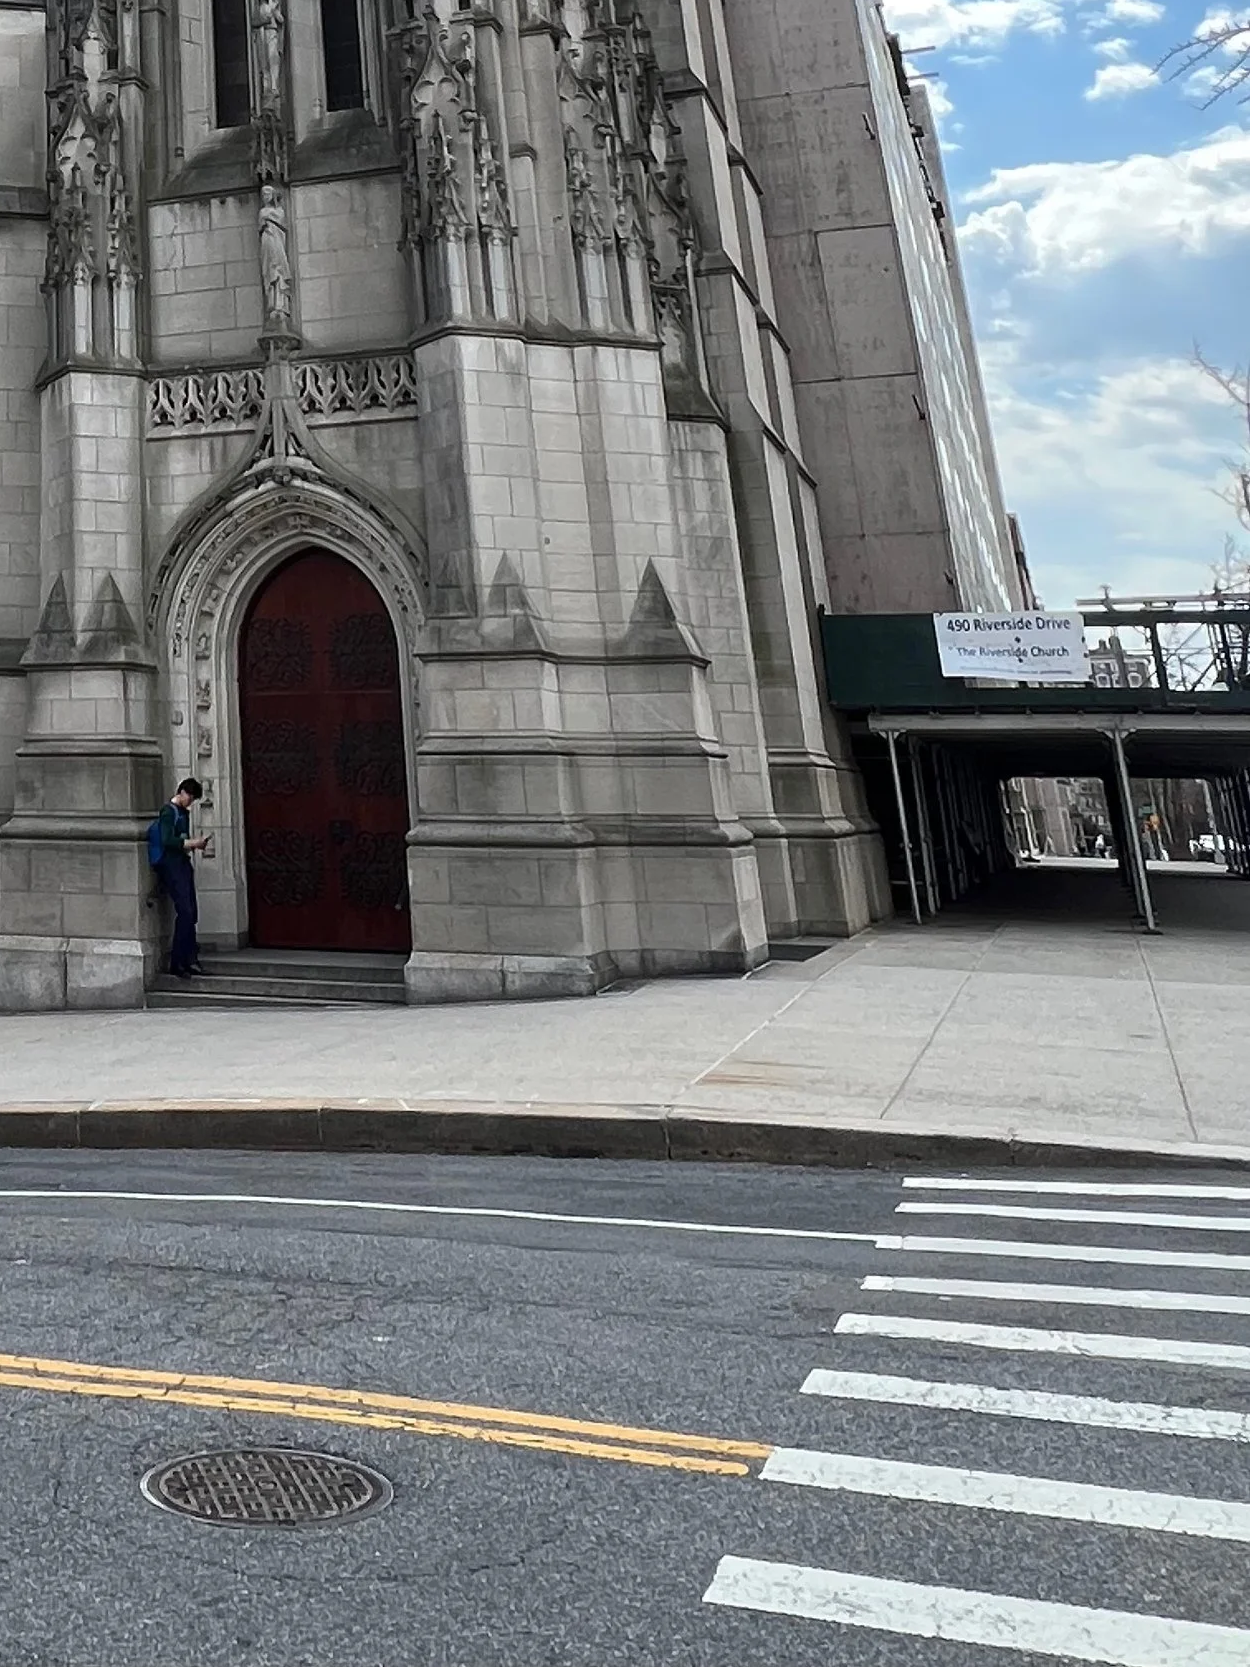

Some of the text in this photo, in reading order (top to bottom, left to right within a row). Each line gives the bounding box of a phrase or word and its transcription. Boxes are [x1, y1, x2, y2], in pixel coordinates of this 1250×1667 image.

[947, 616, 1070, 631] 490 Riverside Drive
[957, 645, 1069, 658] The Riverside Church
